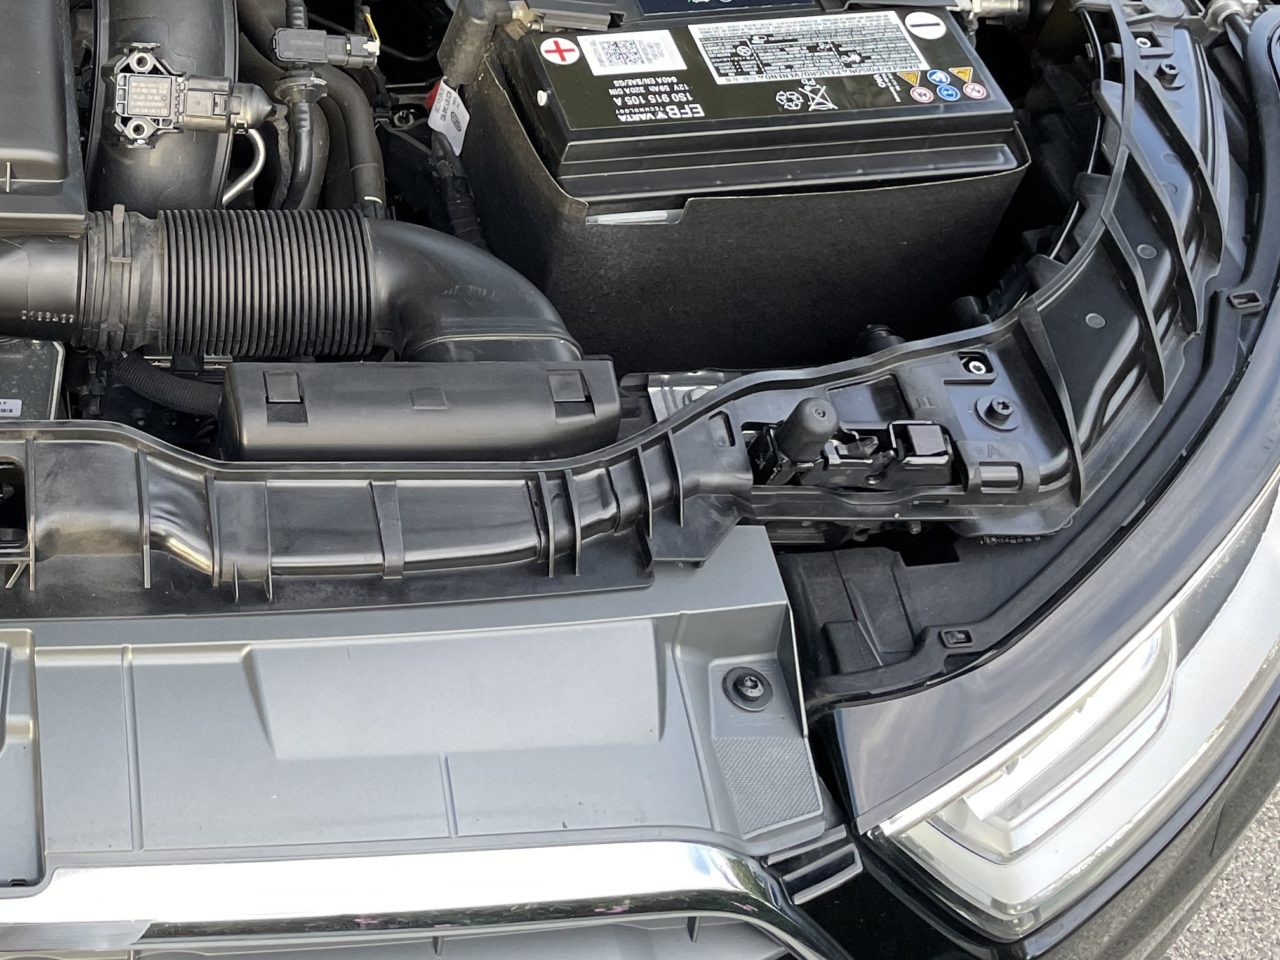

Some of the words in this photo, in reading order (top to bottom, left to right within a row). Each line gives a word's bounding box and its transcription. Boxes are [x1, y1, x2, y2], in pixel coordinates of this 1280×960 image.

[674, 83, 690, 91] 12V
[613, 97, 622, 105] A
[625, 95, 646, 104] 105
[648, 94, 670, 103] 915
[671, 92, 693, 102] 1S0
[666, 103, 705, 119] EFB
[617, 113, 656, 121] VARTA
